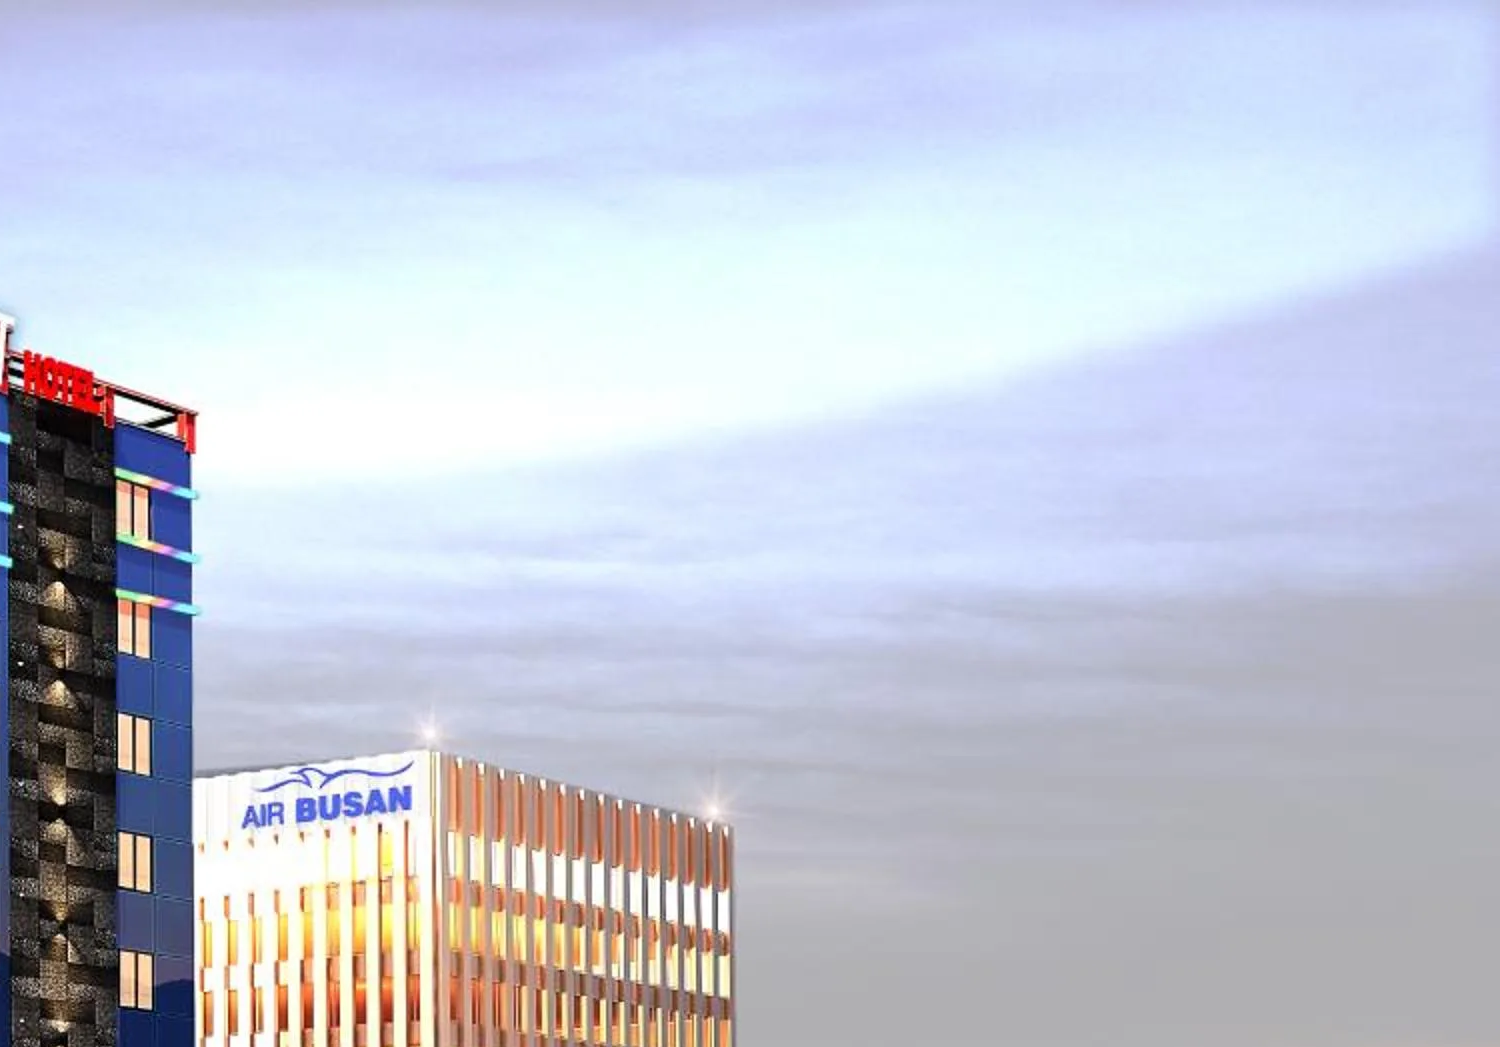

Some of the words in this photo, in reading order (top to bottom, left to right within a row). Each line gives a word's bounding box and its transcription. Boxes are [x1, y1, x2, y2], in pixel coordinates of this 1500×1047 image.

[23, 349, 104, 415] HOTEL
[241, 801, 285, 830] AIR
[295, 785, 413, 824] BUSAN
